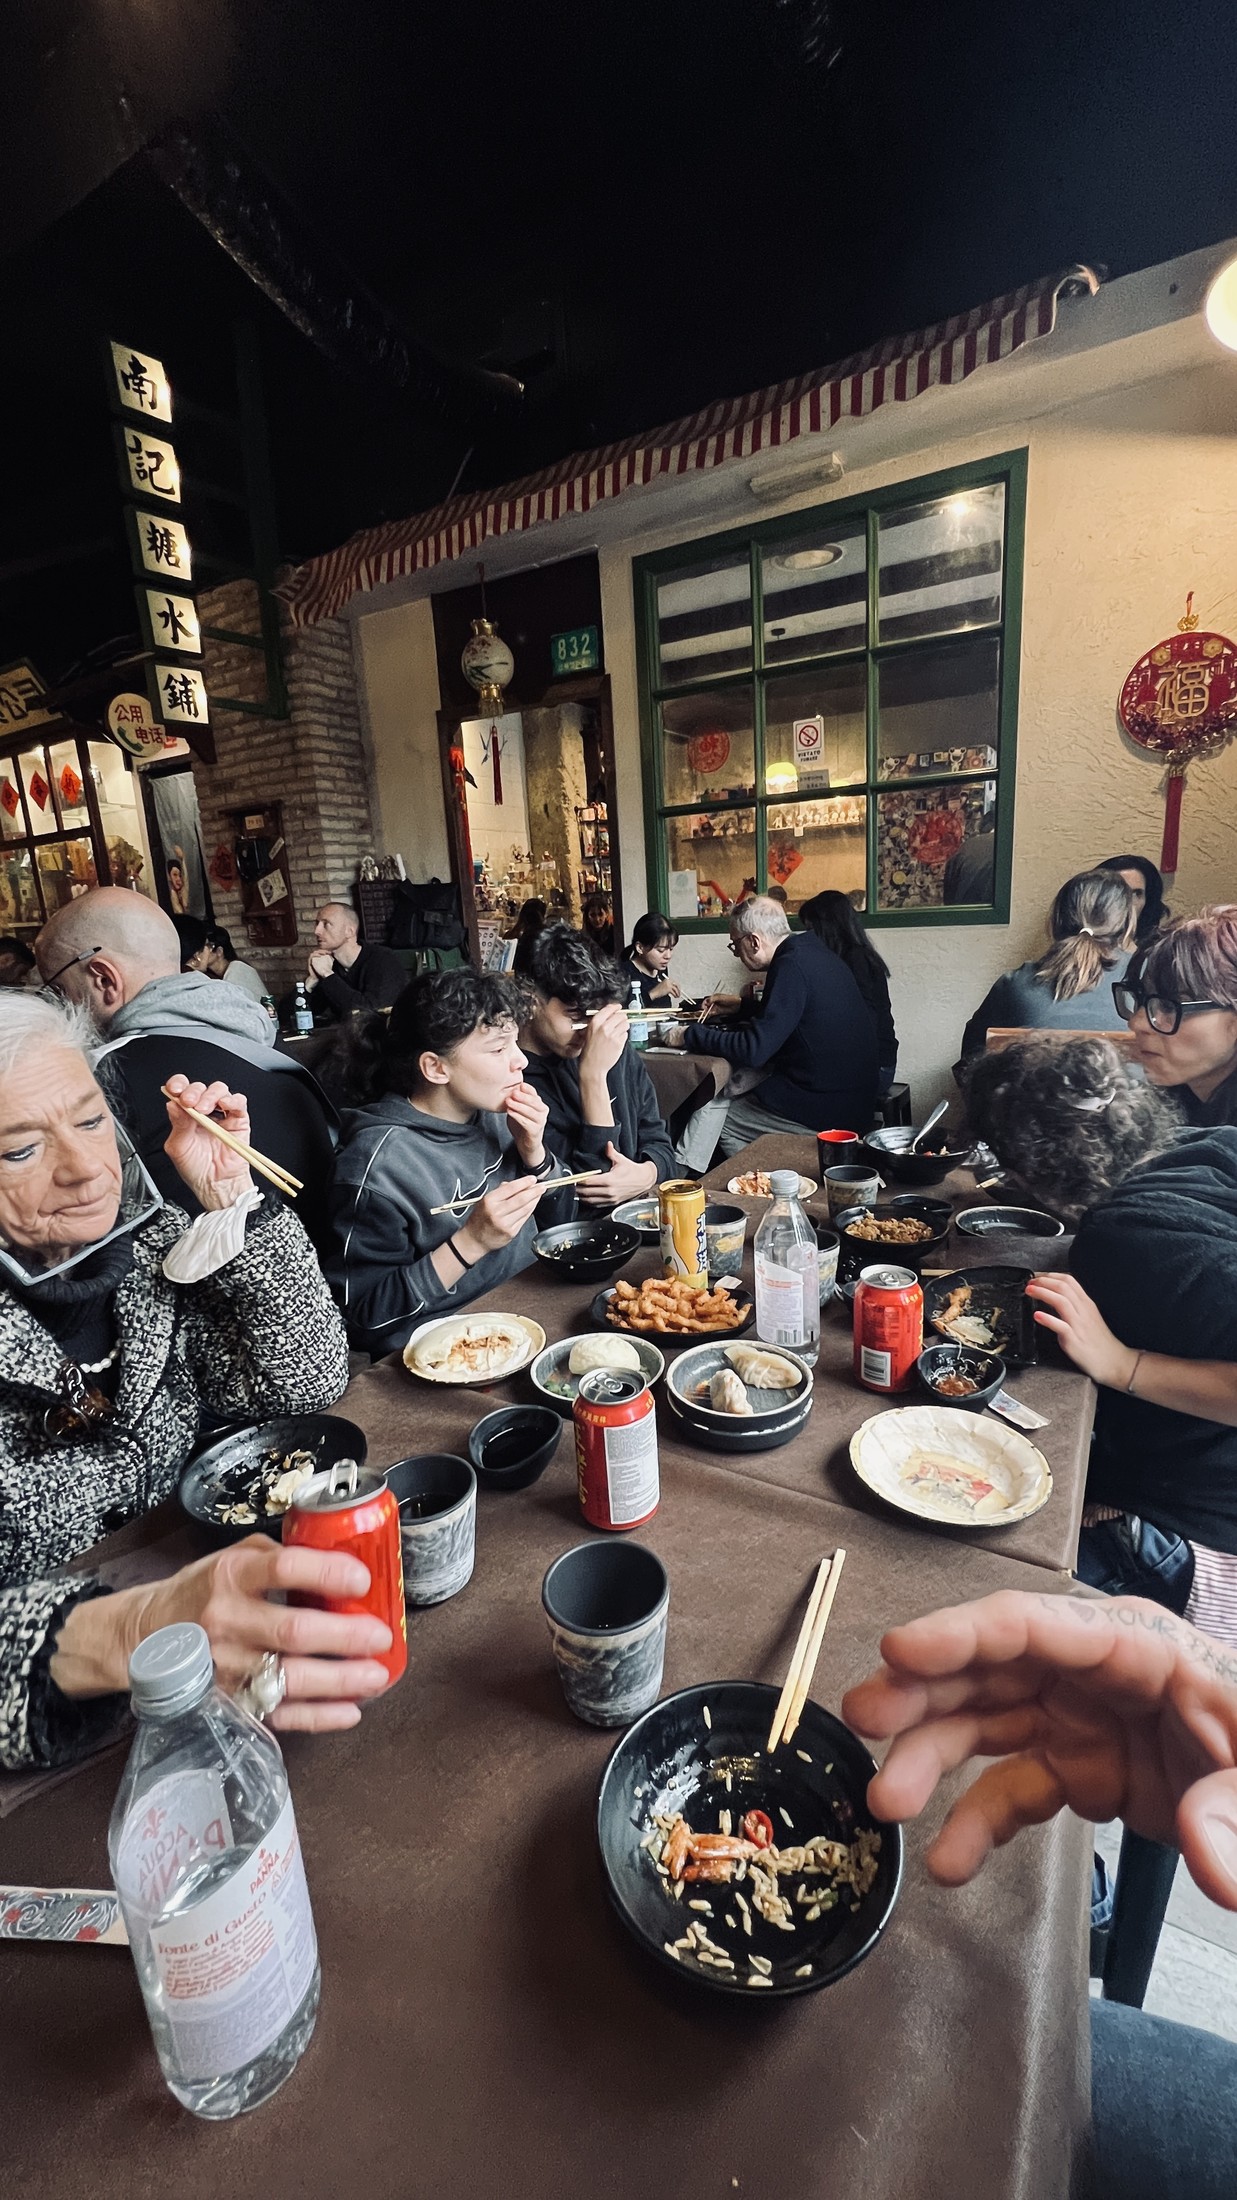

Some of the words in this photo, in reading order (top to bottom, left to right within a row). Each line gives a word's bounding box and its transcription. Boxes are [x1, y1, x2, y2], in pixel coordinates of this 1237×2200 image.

[120, 354, 199, 719] 南記糖水鋪
[557, 632, 592, 661] 832
[1157, 661, 1210, 719] 福
[114, 703, 144, 723] 公用
[134, 726, 164, 744] 电话
[1099, 1606, 1182, 1643] YOUR
[249, 1849, 280, 1895] PANNA
[204, 1929, 219, 1947] di
[224, 1891, 267, 1935] Gusto
